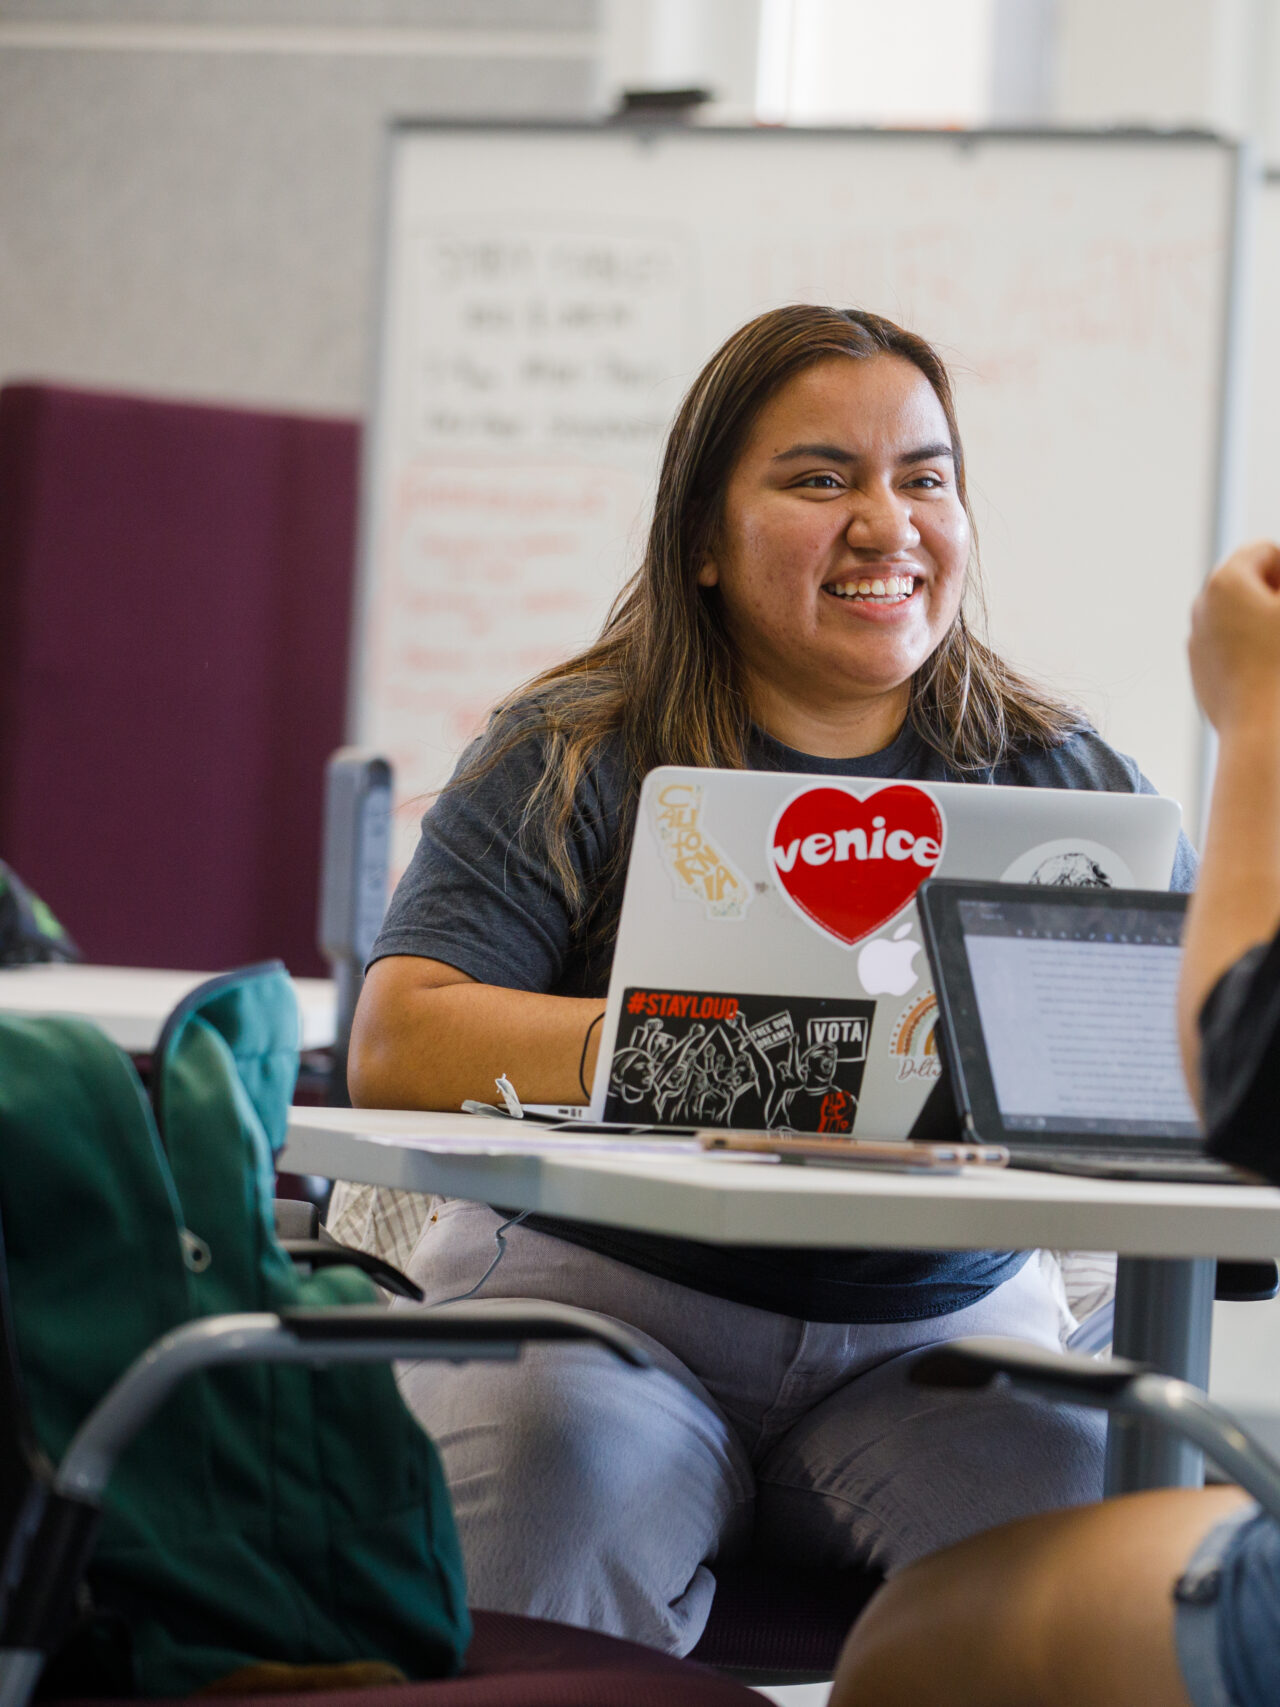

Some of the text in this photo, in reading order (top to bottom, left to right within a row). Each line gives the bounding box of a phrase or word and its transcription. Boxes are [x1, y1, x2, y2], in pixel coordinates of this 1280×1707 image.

[772, 815, 941, 873] venice
[627, 991, 739, 1020] #STAYLOUD
[751, 1023, 773, 1040] FREE
[757, 1027, 791, 1049] DREAMS
[814, 1022, 862, 1043] VOTA
